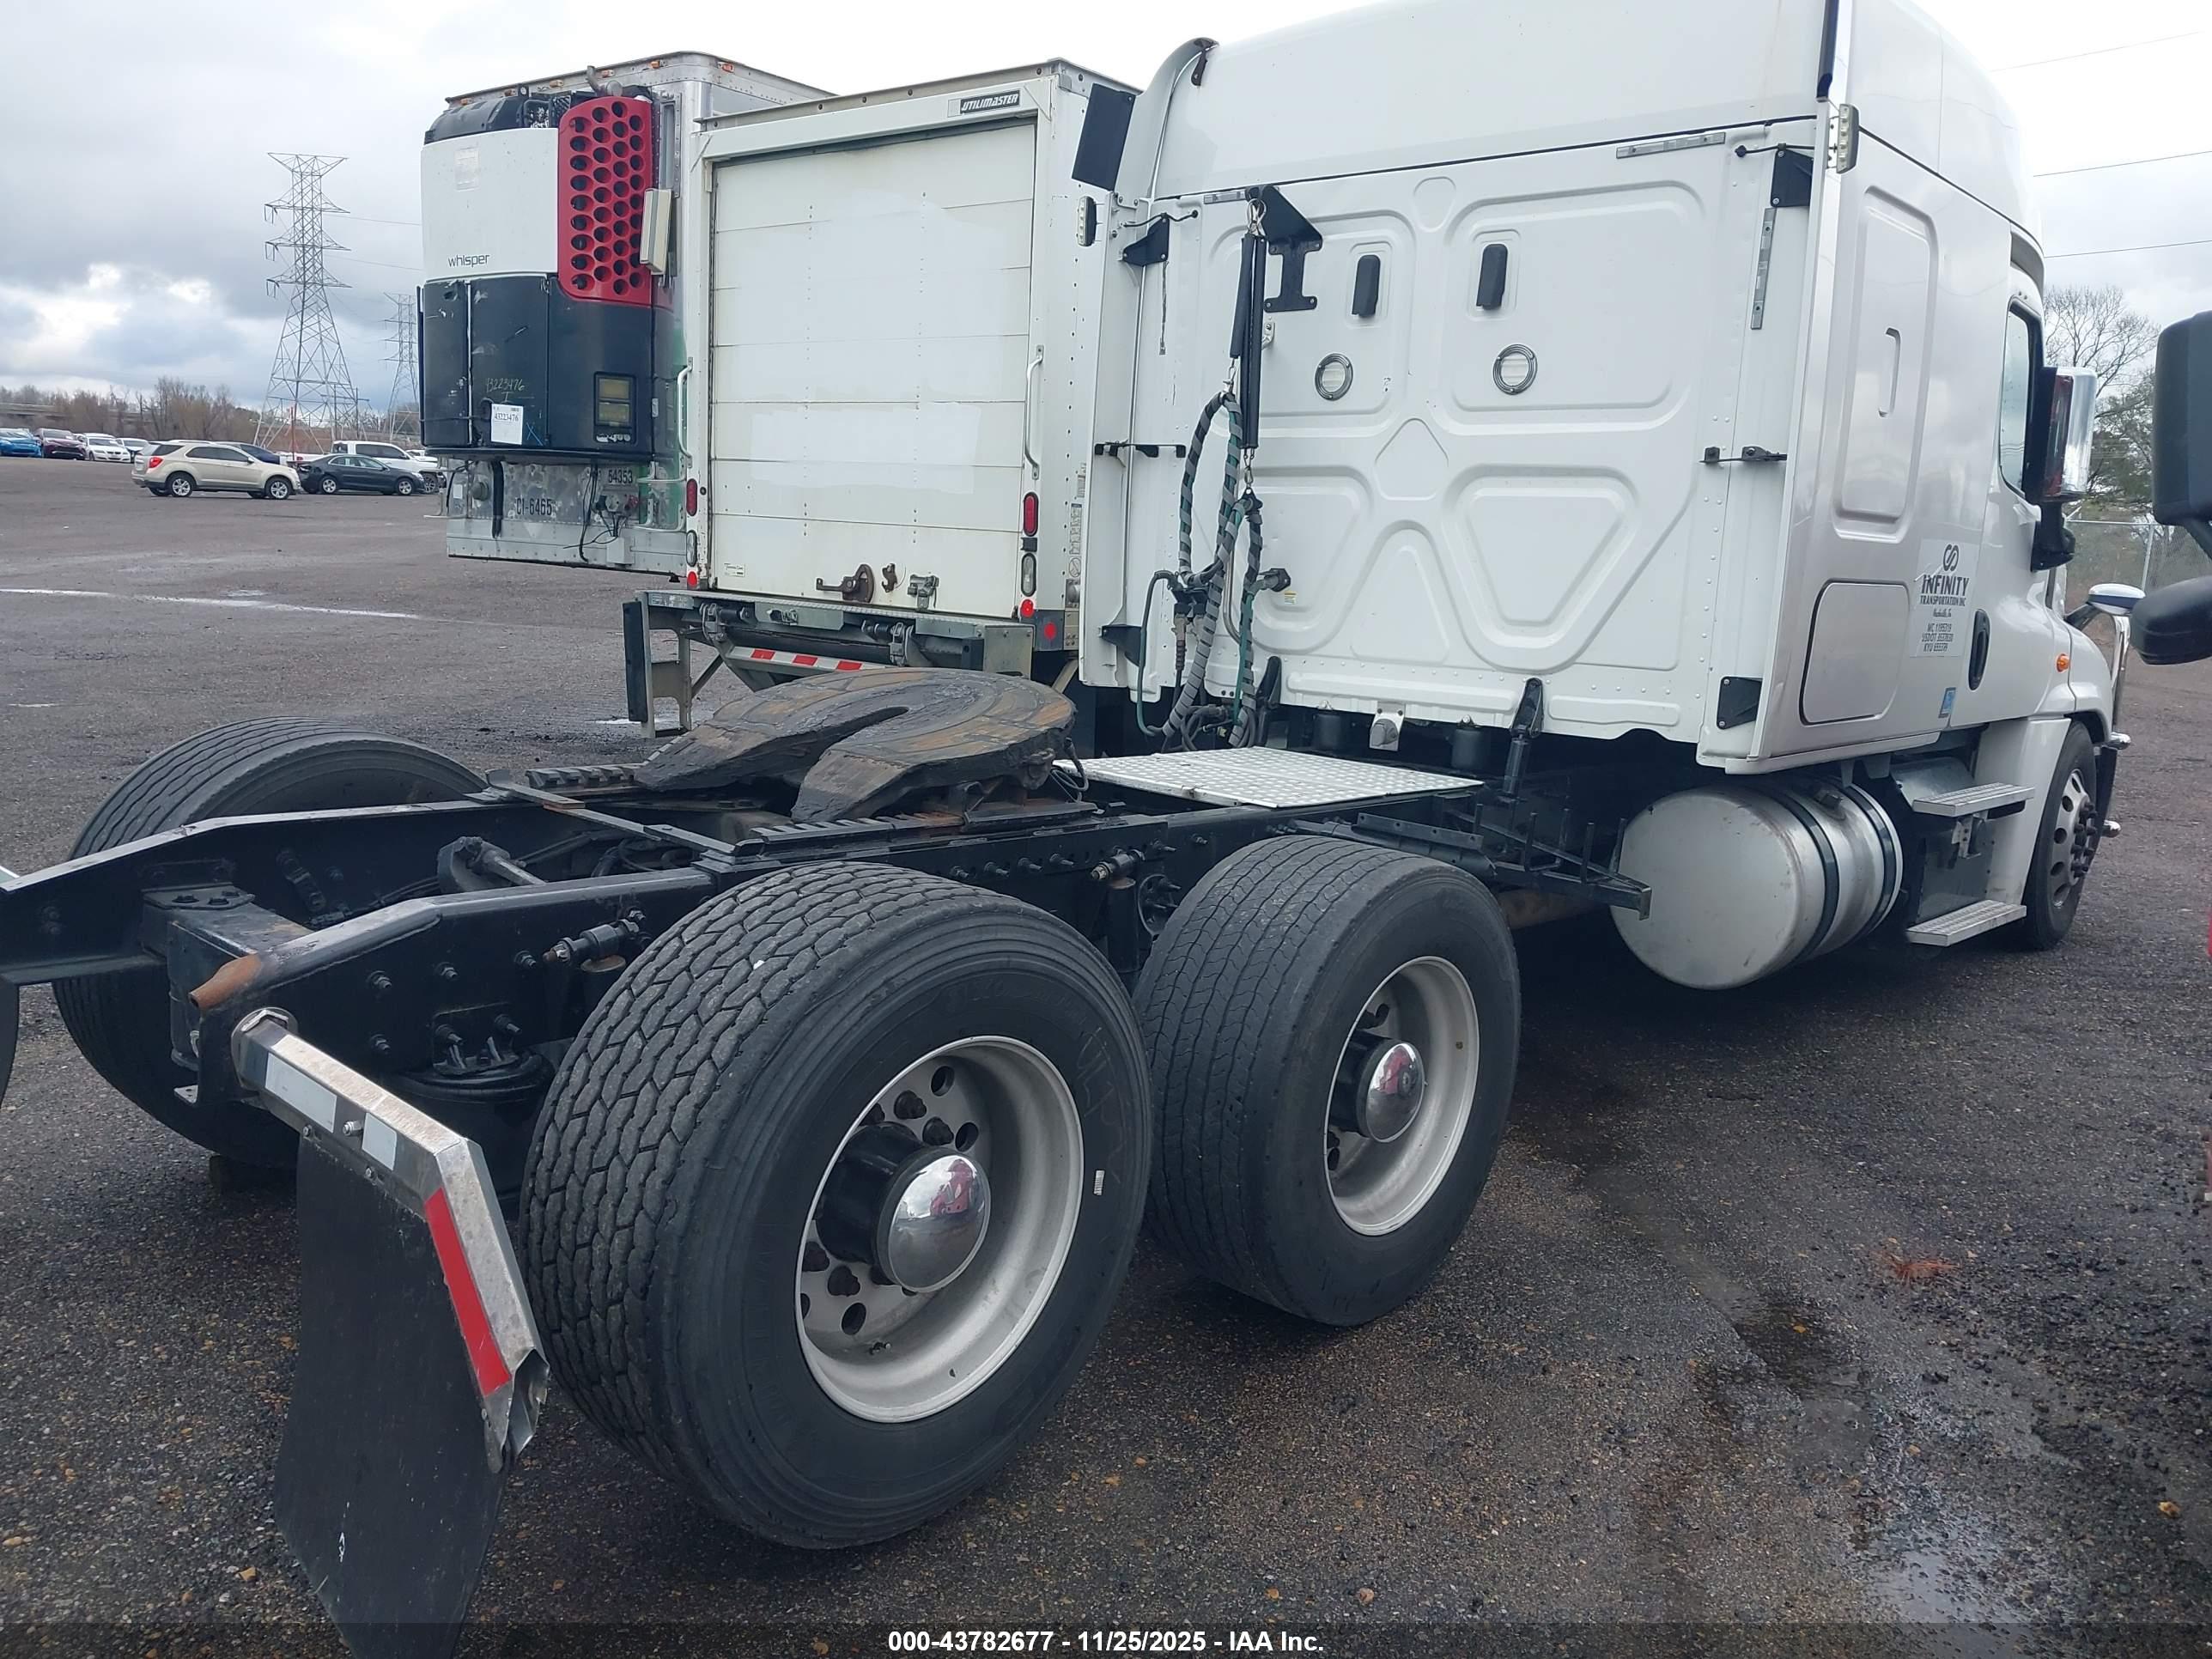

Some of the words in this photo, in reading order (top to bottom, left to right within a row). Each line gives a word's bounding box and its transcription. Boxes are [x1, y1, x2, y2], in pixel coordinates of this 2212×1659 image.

[961, 93, 1019, 111] UTILIMASTER
[447, 254, 490, 268] whisper
[608, 469, 633, 483] 54353
[1921, 574, 1969, 596] INFINITY
